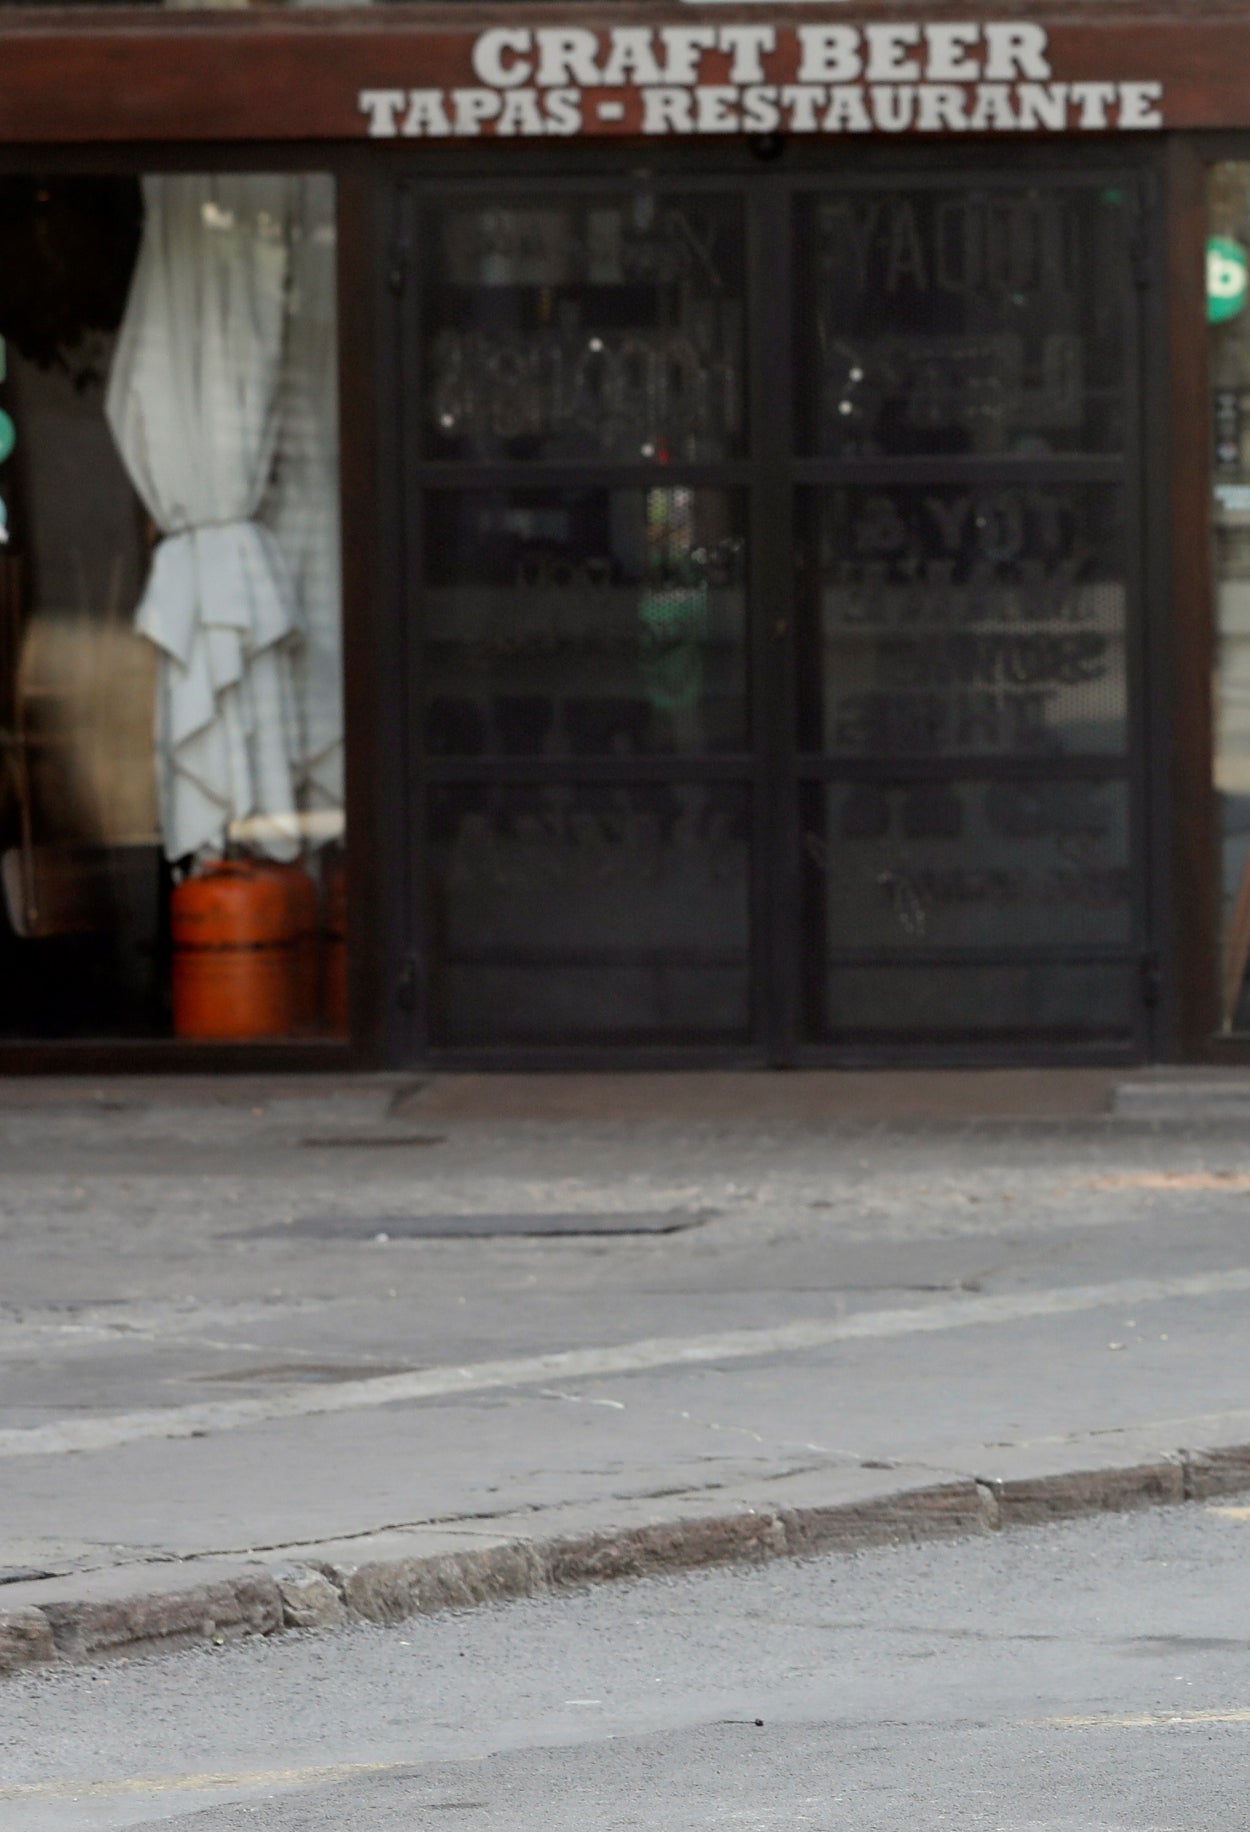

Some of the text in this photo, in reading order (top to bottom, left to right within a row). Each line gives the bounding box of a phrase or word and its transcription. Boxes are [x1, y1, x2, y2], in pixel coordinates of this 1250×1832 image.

[471, 21, 1052, 86] CRAFT BEER
[358, 87, 583, 138] TAPAS
[641, 81, 1163, 135] RESTAURANTE
